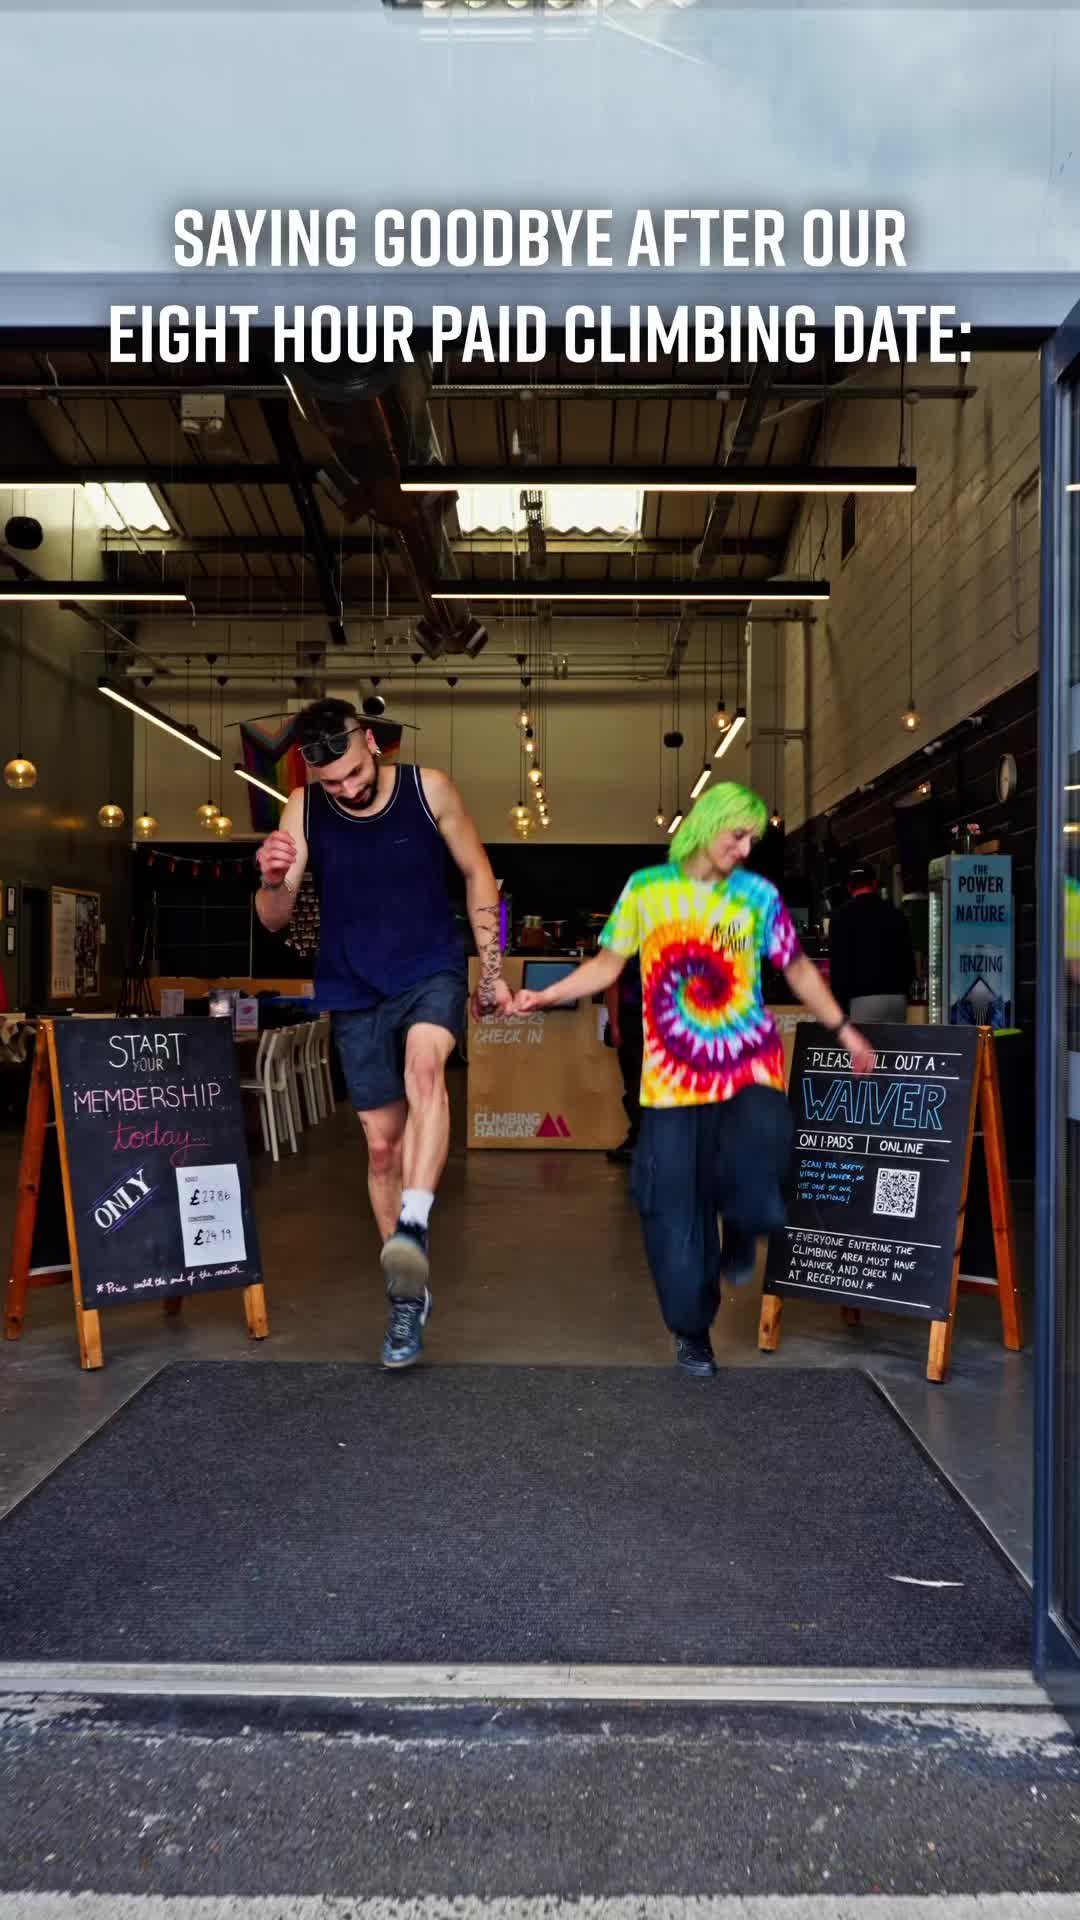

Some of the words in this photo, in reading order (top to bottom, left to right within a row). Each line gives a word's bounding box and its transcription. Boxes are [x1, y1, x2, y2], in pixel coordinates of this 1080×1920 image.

[974, 864, 988, 874] THE
[958, 876, 1003, 893] POWER
[956, 905, 1005, 922] NATURE
[959, 955, 1002, 972] TENZING
[475, 1028, 520, 1044] CHECK
[527, 1028, 544, 1044] IN
[108, 1033, 186, 1068] START
[132, 1057, 165, 1072] YOUR
[894, 1054, 923, 1071] OUT
[924, 1056, 936, 1072] A
[73, 1083, 221, 1113] MEMBERSHIP
[802, 1077, 947, 1131] WAIVER
[474, 1112, 541, 1124] CLIMBING
[474, 1125, 535, 1137] HANGAR
[799, 1133, 817, 1147] ON
[879, 1140, 924, 1155] ONLINE
[800, 1170, 819, 1178] VIDEO
[801, 1160, 822, 1168] SCAN
[840, 1163, 864, 1172] SAFETY
[811, 1183, 826, 1191] ONE
[95, 1169, 152, 1228] ONLY
[847, 1239, 892, 1253] ENTERING
[894, 1245, 916, 1256] THE
[792, 1244, 838, 1260] CLIMBING
[840, 1252, 863, 1263] AREA
[866, 1257, 890, 1267] MUST
[893, 1259, 917, 1270] HAVE
[788, 1270, 802, 1281] AT
[790, 1257, 797, 1266] A
[800, 1258, 835, 1274] WAIVER,
[838, 1264, 859, 1276] AND
[861, 1267, 888, 1279] CHECK
[891, 1271, 903, 1282] IN
[187, 1272, 195, 1286] of
[199, 1270, 212, 1280] the
